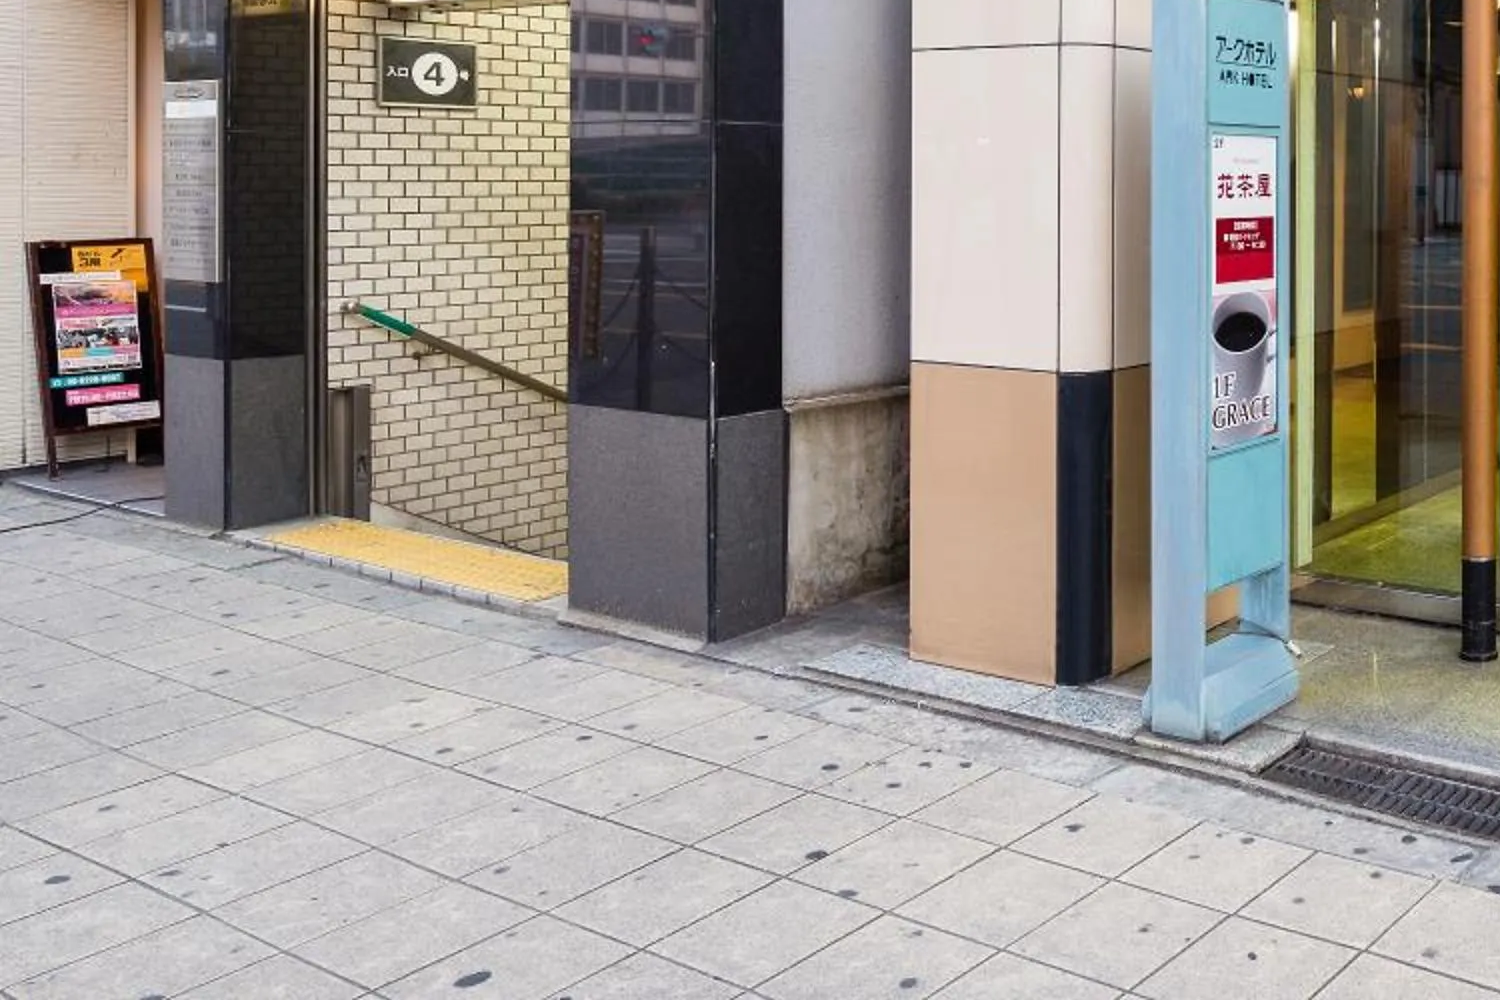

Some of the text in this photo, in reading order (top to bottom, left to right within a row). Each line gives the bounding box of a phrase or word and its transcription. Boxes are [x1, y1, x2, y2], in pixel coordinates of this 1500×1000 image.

[1216, 35, 1276, 66] アークホテル
[423, 61, 446, 87] 4
[1219, 68, 1273, 89] ARK HOTEL
[1217, 173, 1272, 199] 花茶屋
[1213, 396, 1271, 429] GRACE
